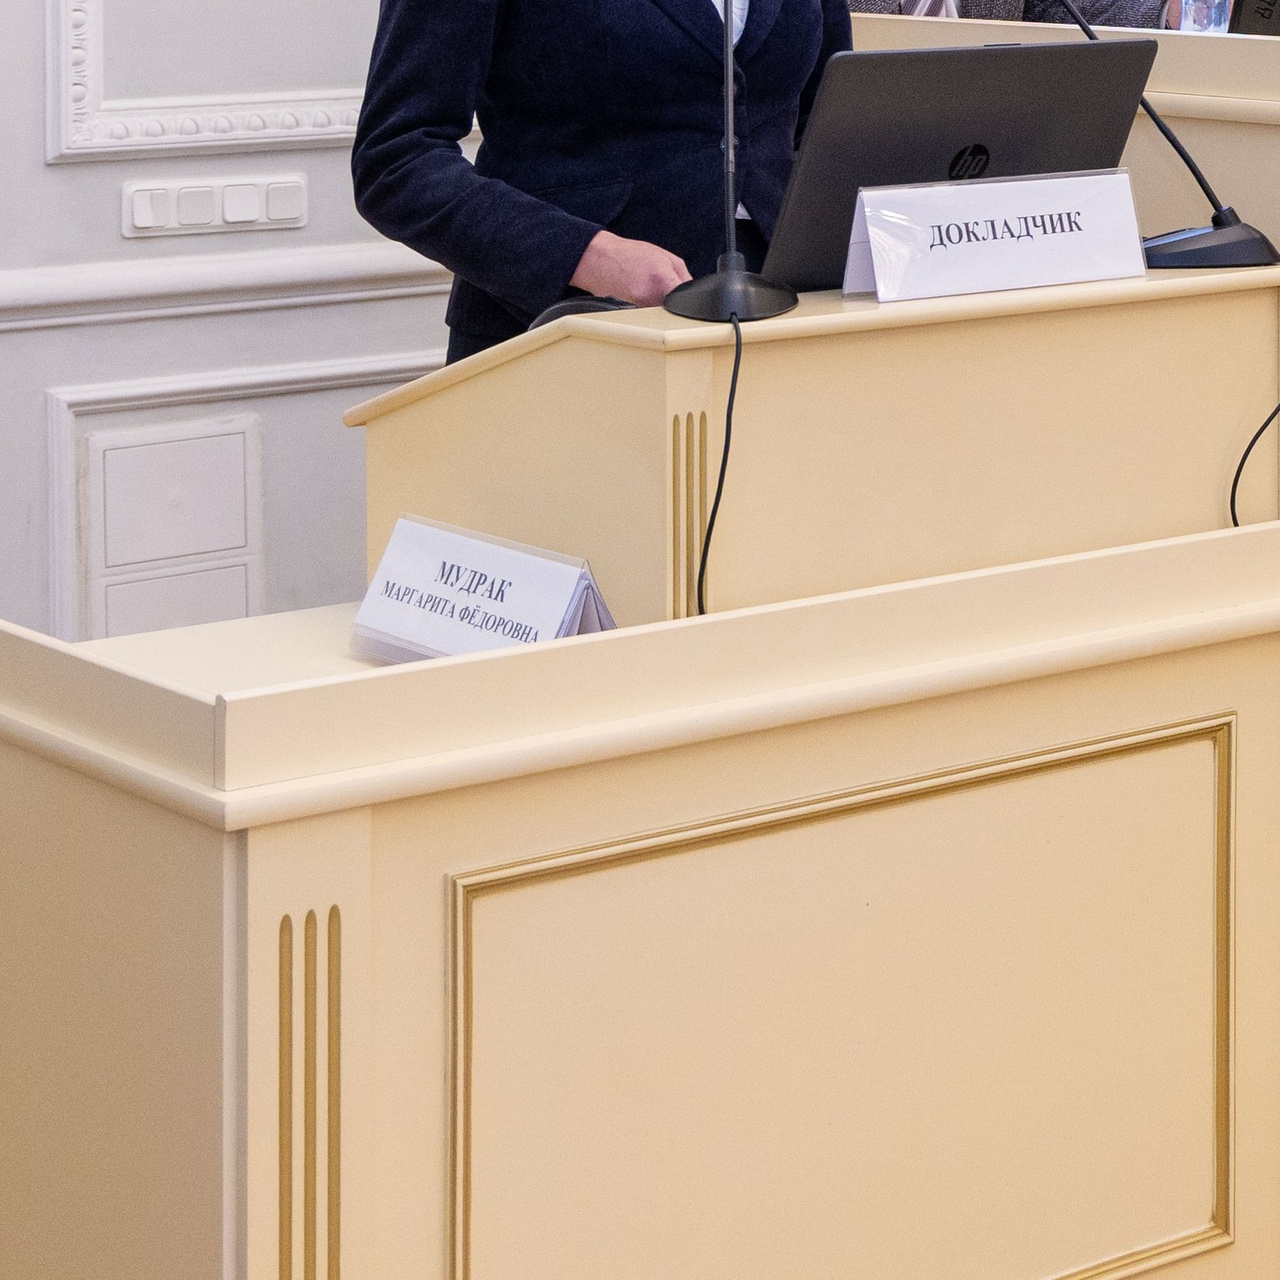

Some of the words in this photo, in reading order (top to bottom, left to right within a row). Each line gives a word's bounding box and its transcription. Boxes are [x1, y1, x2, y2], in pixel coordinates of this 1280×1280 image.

[929, 211, 1083, 251] ДОКЛАДЧИК
[434, 561, 512, 603] МУДРАК
[380, 581, 455, 619] МАРГАРИТА
[458, 605, 540, 643] ФЁДОРОВНА
